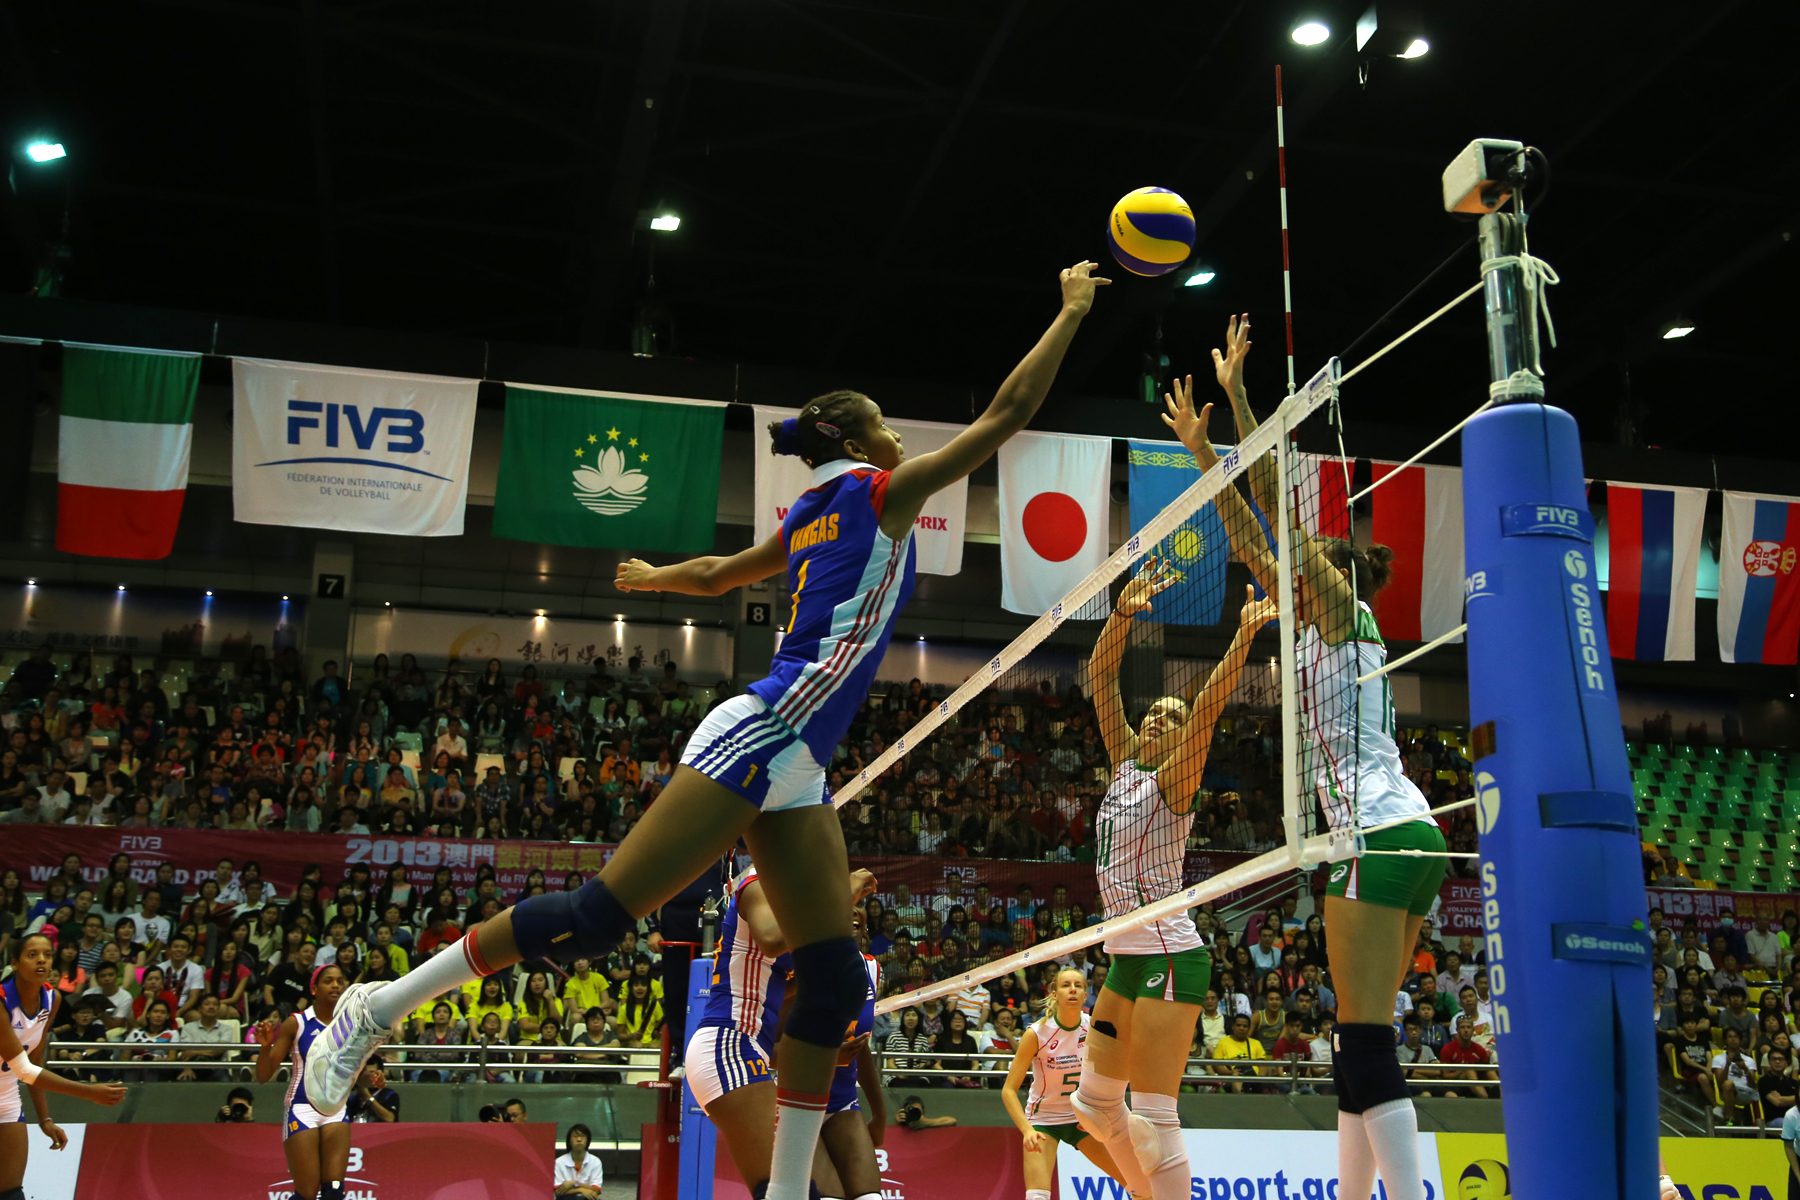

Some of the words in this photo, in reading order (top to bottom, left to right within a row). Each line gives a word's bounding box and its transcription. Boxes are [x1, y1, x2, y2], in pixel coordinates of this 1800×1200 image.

[287, 400, 425, 453] FIVB
[1223, 450, 1239, 474] FIVB
[287, 472, 345, 485] FÉDÉRATION
[347, 478, 423, 492] INTERNATIONALE
[320, 486, 333, 496] DE
[336, 487, 391, 501] VOLLEYBALL
[1537, 506, 1579, 526] FIVB
[1127, 536, 1140, 556] FIVB
[325, 577, 339, 595] 7
[752, 606, 764, 623] 8
[1570, 582, 1604, 691] Senoh
[741, 763, 759, 788] 1
[120, 836, 163, 850] FIVB
[344, 839, 442, 867] 2013
[1098, 818, 1114, 868] 11
[1481, 861, 1511, 1035] Senoh
[1582, 934, 1646, 955] Senoh
[746, 1058, 768, 1077] 12
[288, 1120, 299, 1132] 18
